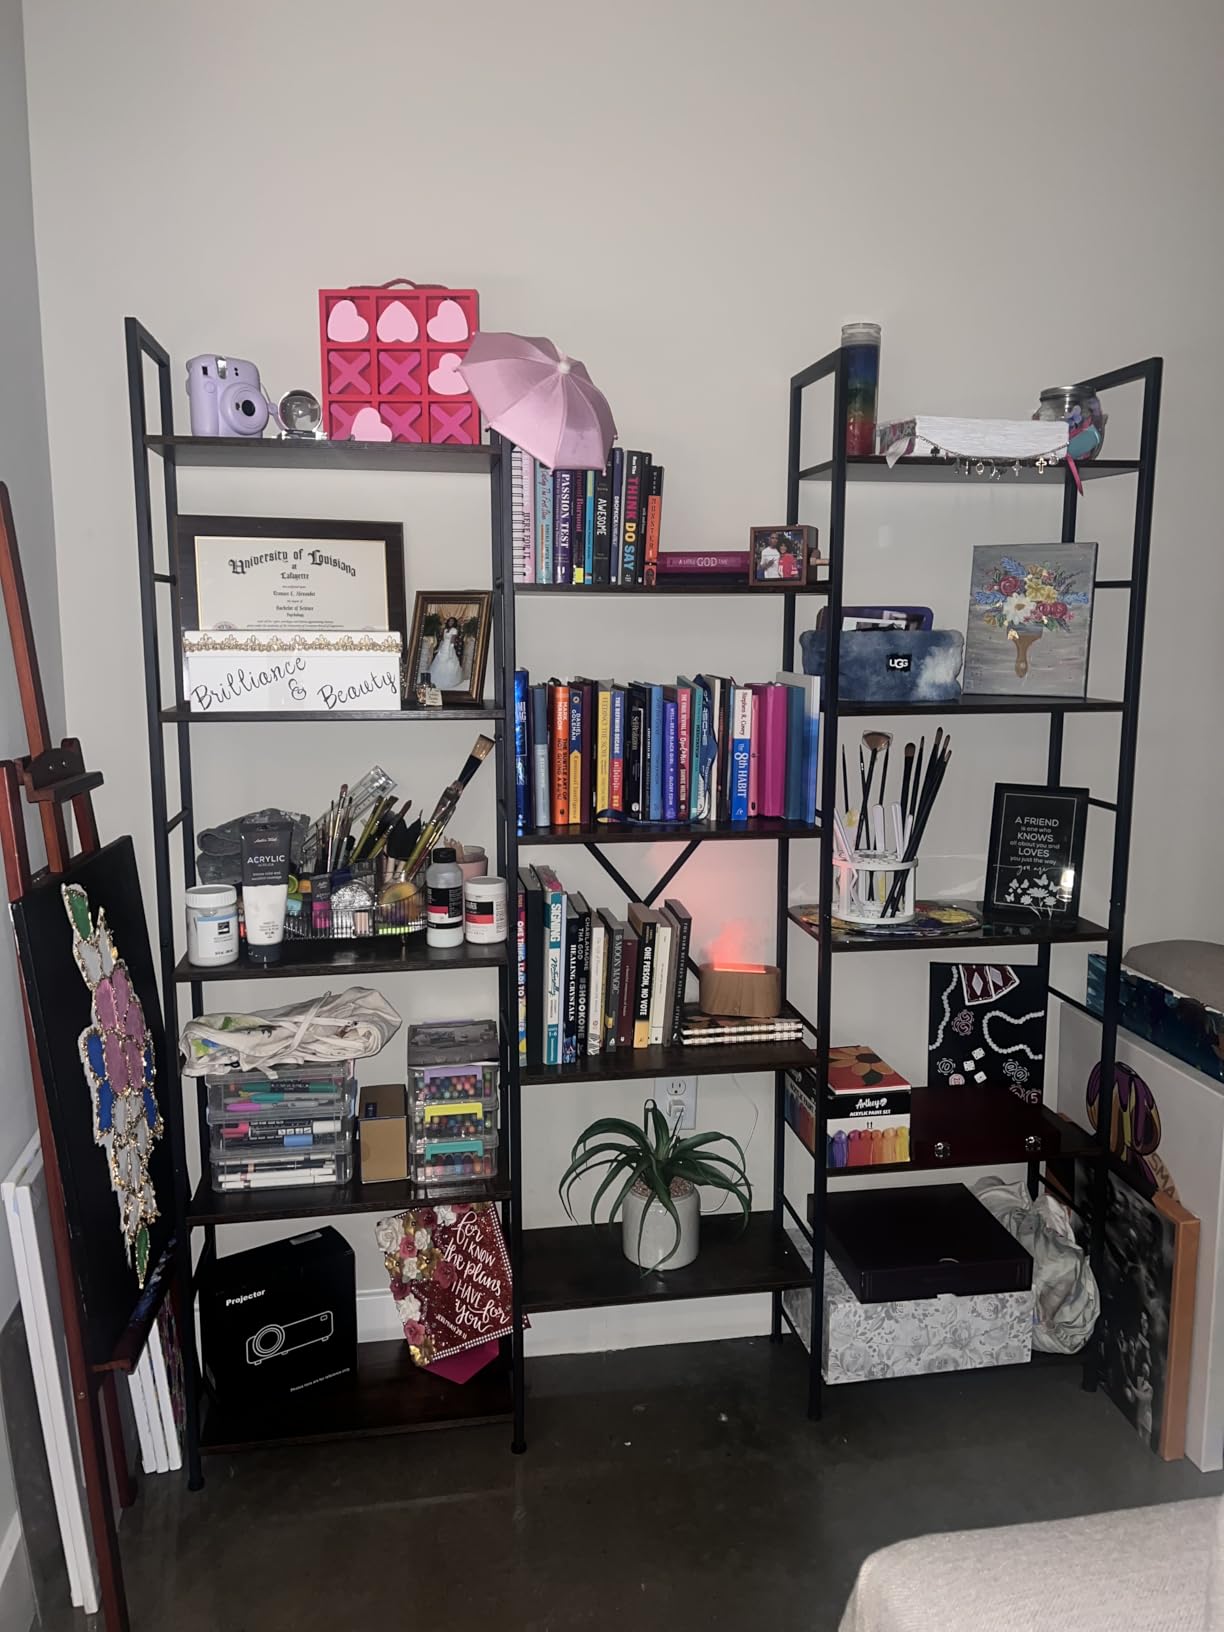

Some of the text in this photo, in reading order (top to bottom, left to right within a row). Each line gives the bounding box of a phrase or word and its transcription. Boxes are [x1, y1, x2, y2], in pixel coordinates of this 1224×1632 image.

[560, 474, 571, 548] PASSION TEST
[626, 477, 640, 519] THINK
[576, 498, 584, 532] Burnout
[596, 498, 607, 536] AWESOME
[523, 512, 531, 560] HERE FOR IT
[625, 522, 637, 542] DO
[228, 548, 356, 577] University of Louisiana
[624, 545, 635, 570] SAY
[696, 557, 718, 567] GOD
[889, 658, 908, 668] UGG
[191, 657, 306, 710] Brilliance
[288, 678, 306, 701] &
[317, 671, 397, 710] Beauty
[739, 720, 747, 736] Covey
[734, 752, 749, 768] 8th
[562, 791, 568, 800] OF
[737, 770, 748, 798] HABIT
[1024, 817, 1059, 827] FRIEND
[1017, 832, 1054, 842] KNOWS
[247, 855, 285, 864] ACRYLIC
[1019, 848, 1049, 857] LOVES
[550, 903, 561, 942] SIGNING
[548, 957, 560, 996] Naturally
[612, 941, 622, 994] MOON MAGIC
[639, 947, 652, 1015] ONE PERSON, NO VOTE
[517, 986, 524, 996] TO
[568, 944, 577, 1022] HEALING CRYSTALS
[578, 978, 587, 1039] #SHOOKONE
[1017, 1071, 1025, 1079] 10
[1031, 1094, 1038, 1104] 5
[451, 1210, 484, 1245] for
[444, 1238, 501, 1296] the plans
[463, 1240, 496, 1266] I KNOW
[226, 1289, 266, 1306] Projector
[451, 1281, 510, 1323] I HAVE for
[455, 1298, 493, 1332] you
